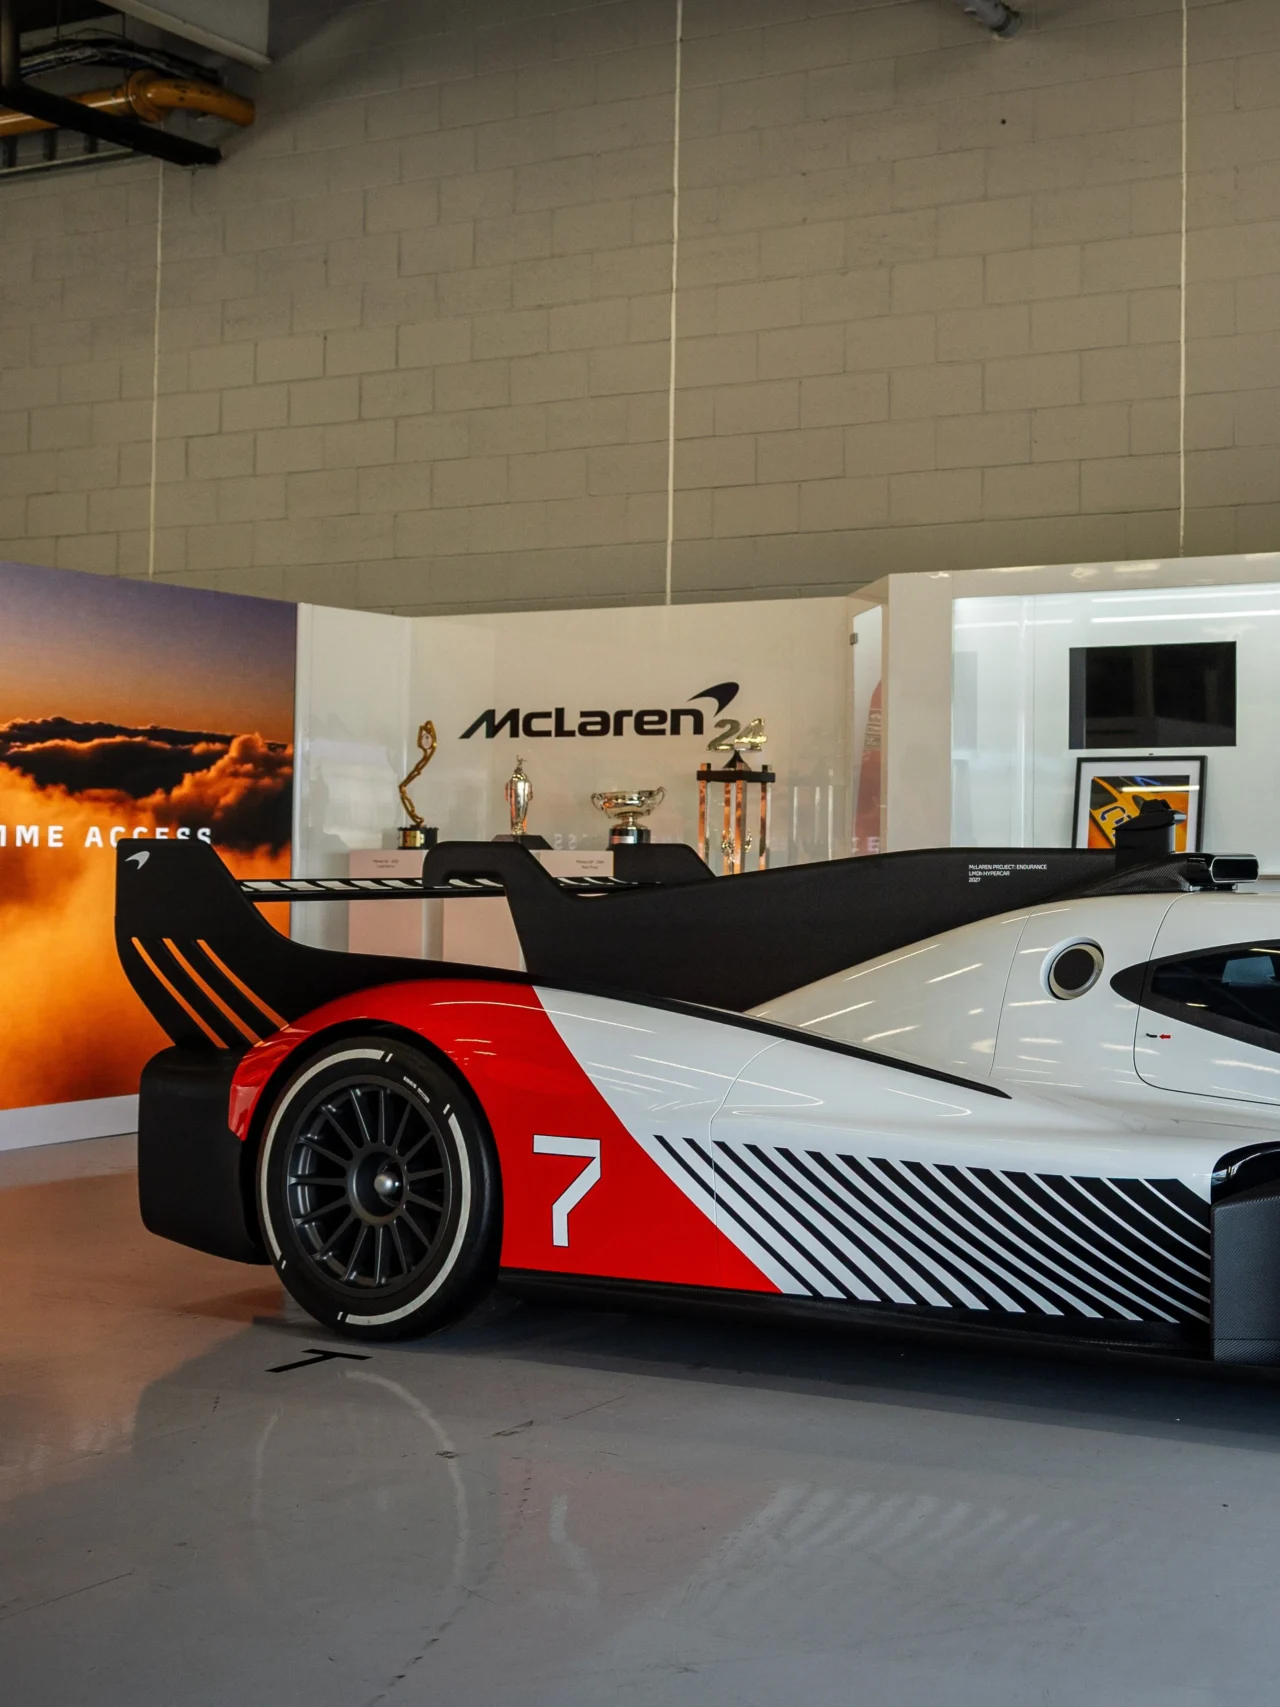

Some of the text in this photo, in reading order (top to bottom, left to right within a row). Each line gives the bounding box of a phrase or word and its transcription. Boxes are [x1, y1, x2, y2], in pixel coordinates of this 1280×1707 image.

[458, 707, 704, 739] McLaren
[706, 718, 767, 751] 24
[532, 1134, 602, 1247] 7
